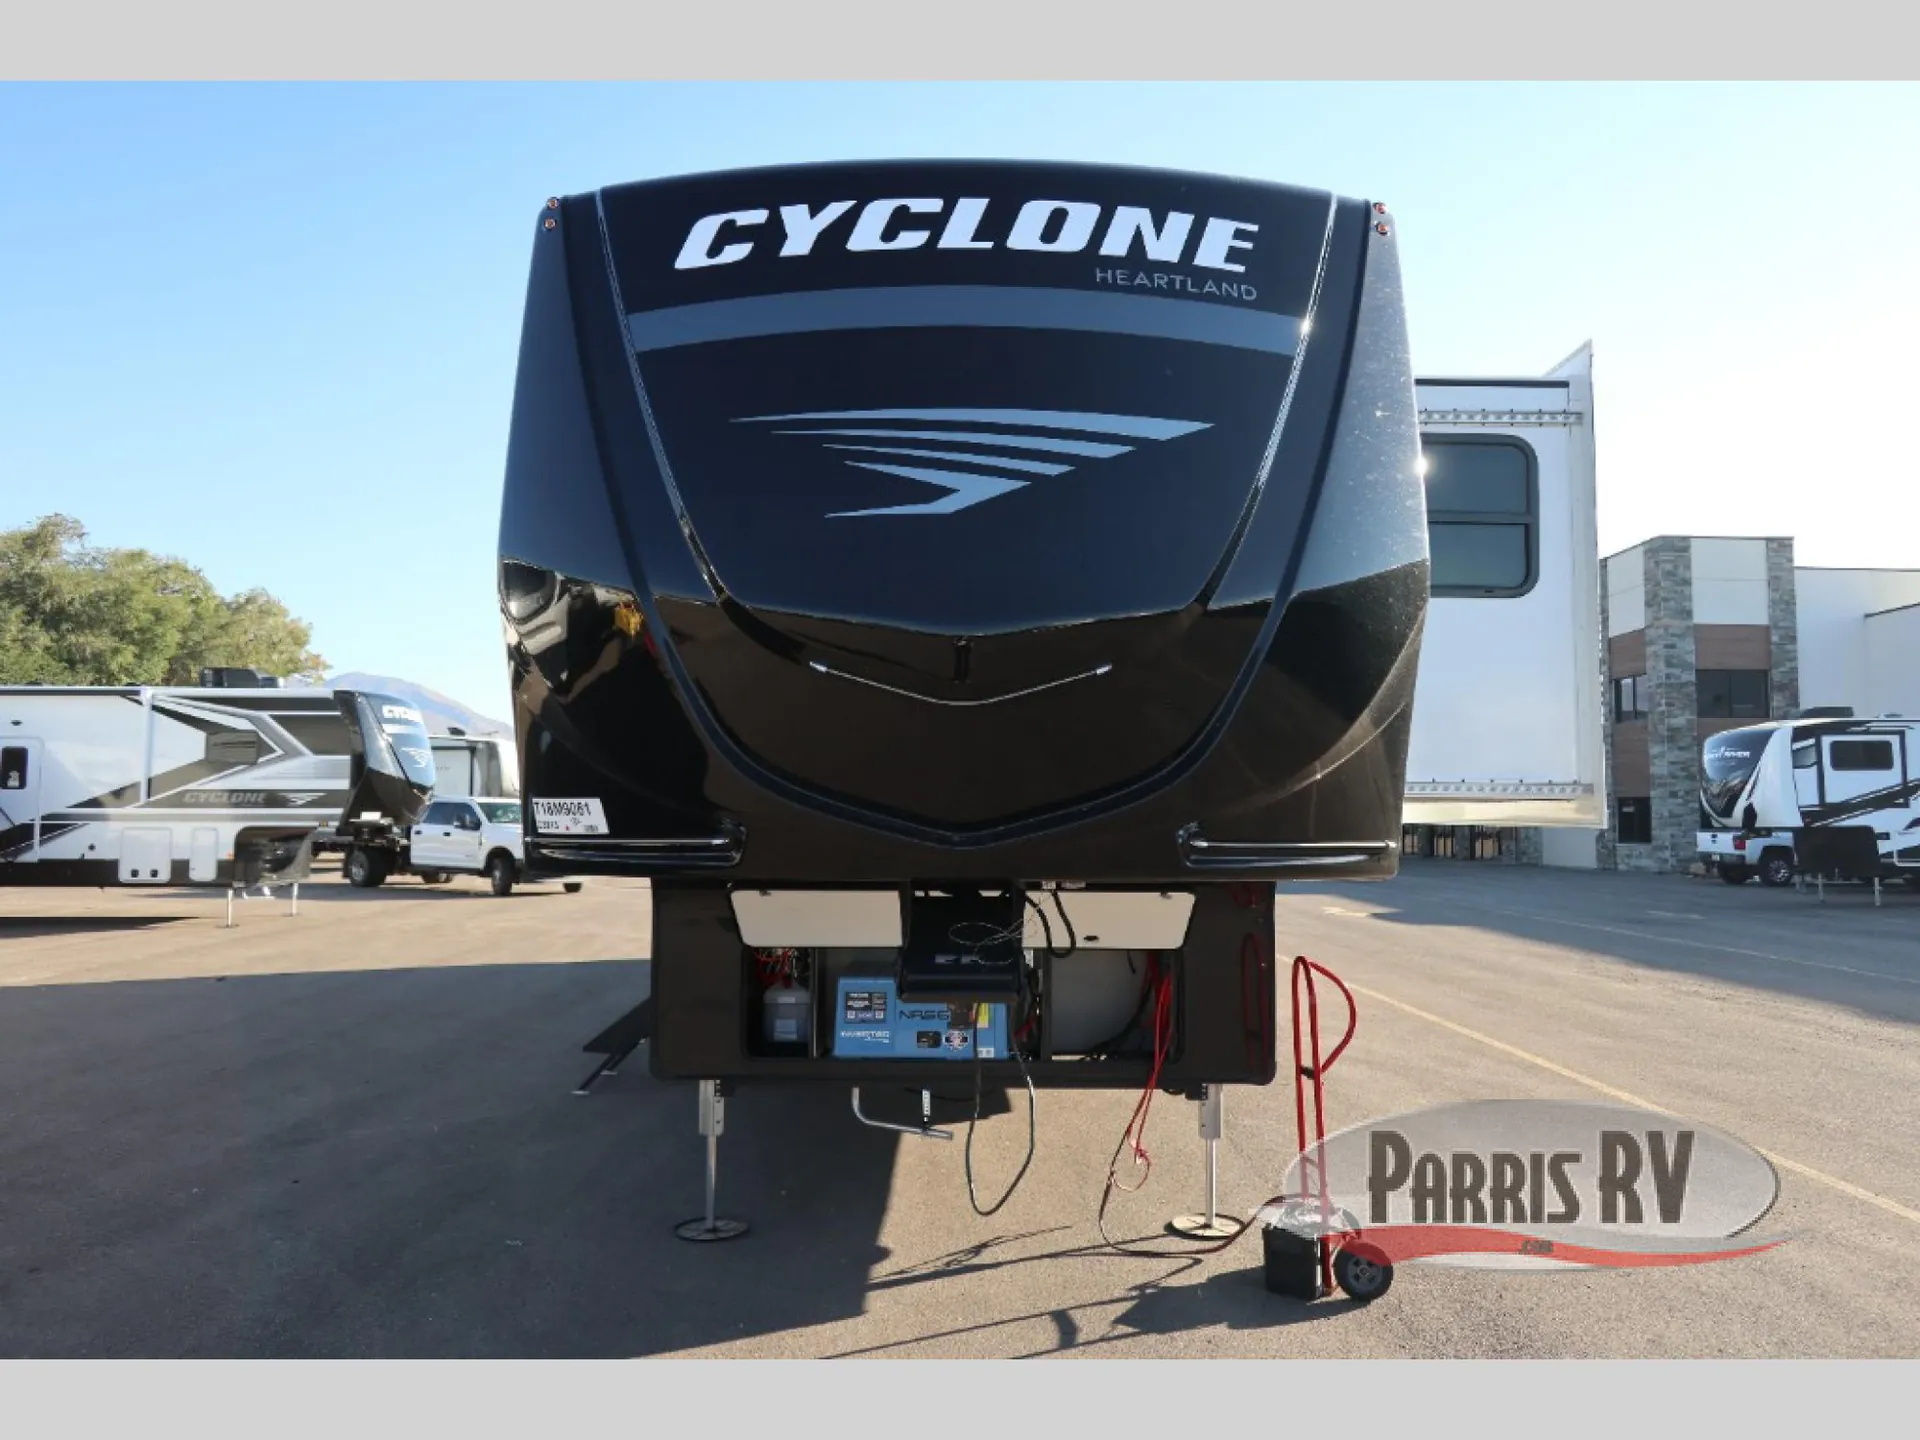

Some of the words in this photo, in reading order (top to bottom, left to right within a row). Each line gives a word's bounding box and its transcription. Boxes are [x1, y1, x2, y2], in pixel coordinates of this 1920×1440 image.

[674, 197, 1260, 273] CYCLONE
[1095, 267, 1258, 301] HEARTLAND
[182, 792, 266, 804] CYCLONE
